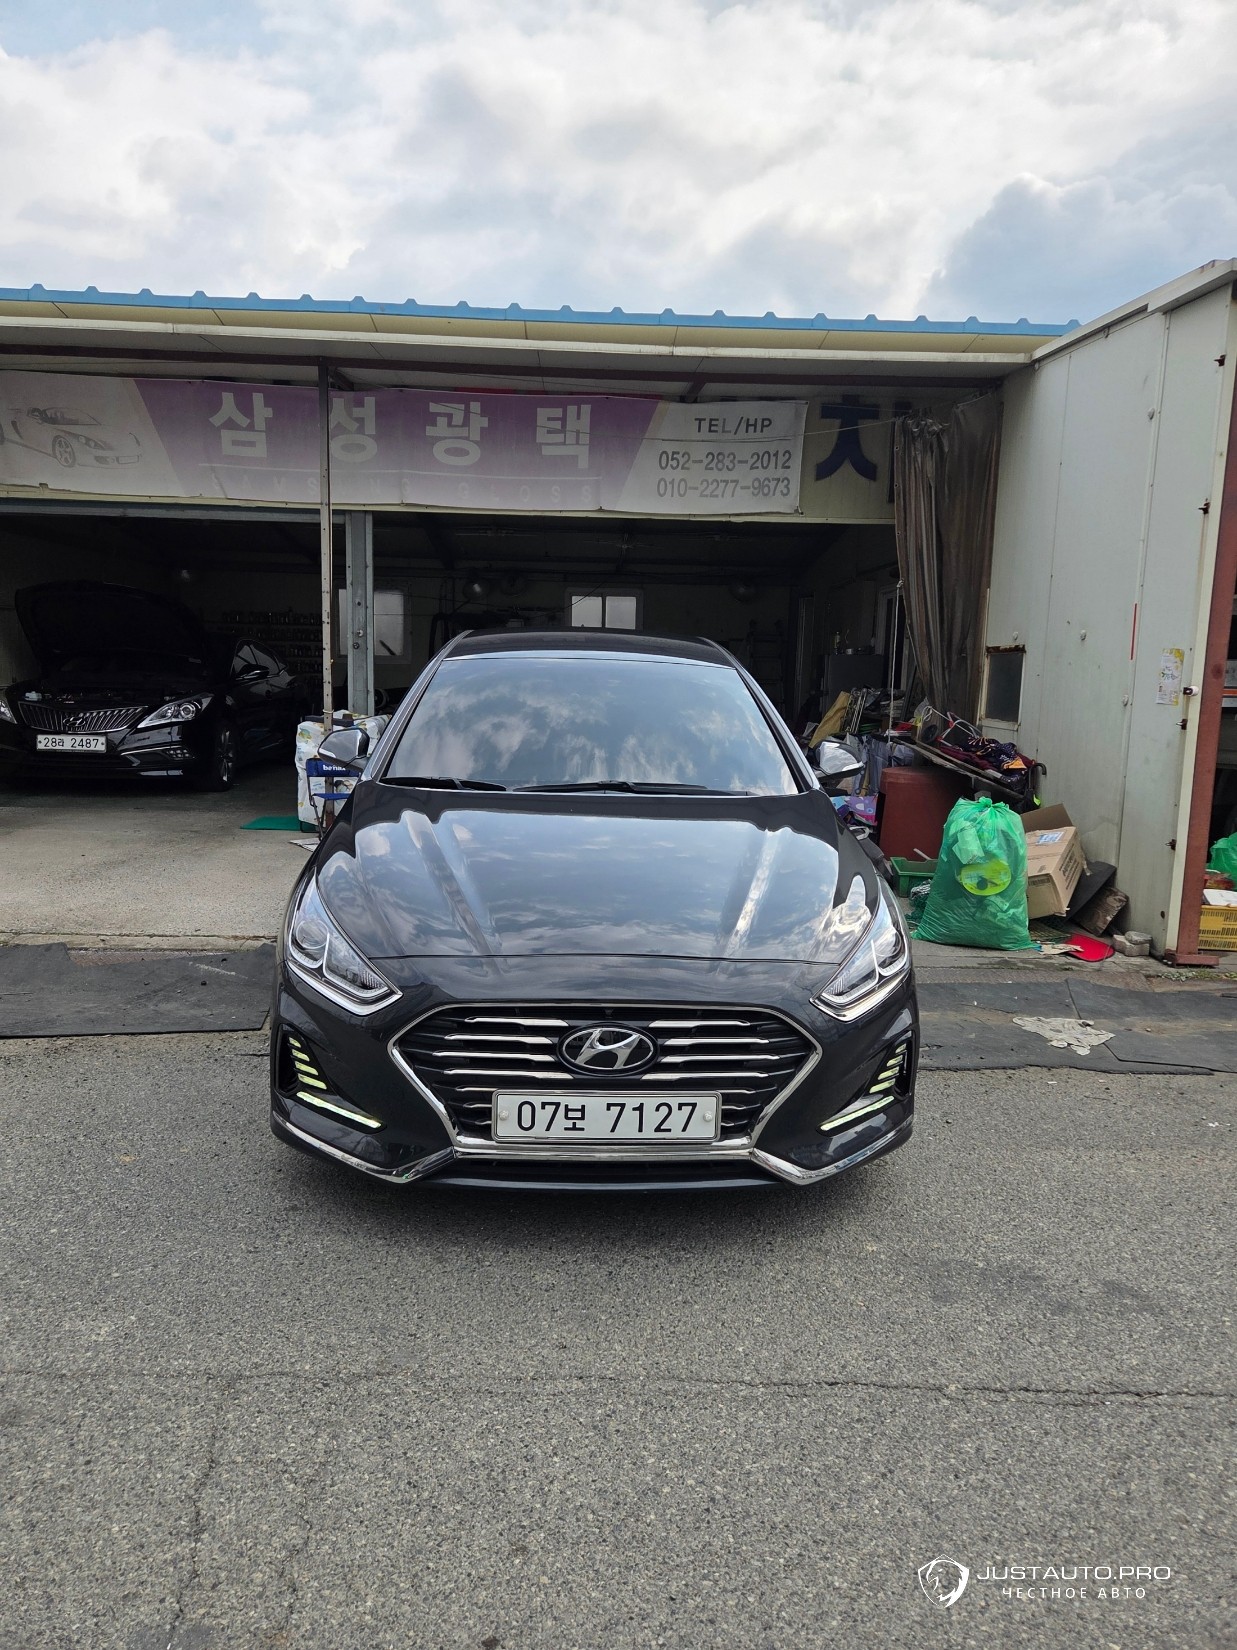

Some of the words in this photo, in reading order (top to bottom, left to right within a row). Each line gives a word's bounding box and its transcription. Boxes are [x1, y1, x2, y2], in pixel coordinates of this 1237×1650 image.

[209, 391, 591, 469] 삼성광택
[694, 416, 772, 435] TEL/HP
[658, 449, 792, 472] 052-283-2012
[656, 476, 791, 499] 010-2277-9673
[71, 737, 99, 749] 2487
[517, 1100, 586, 1132] 07보
[606, 1102, 698, 1133] 7127
